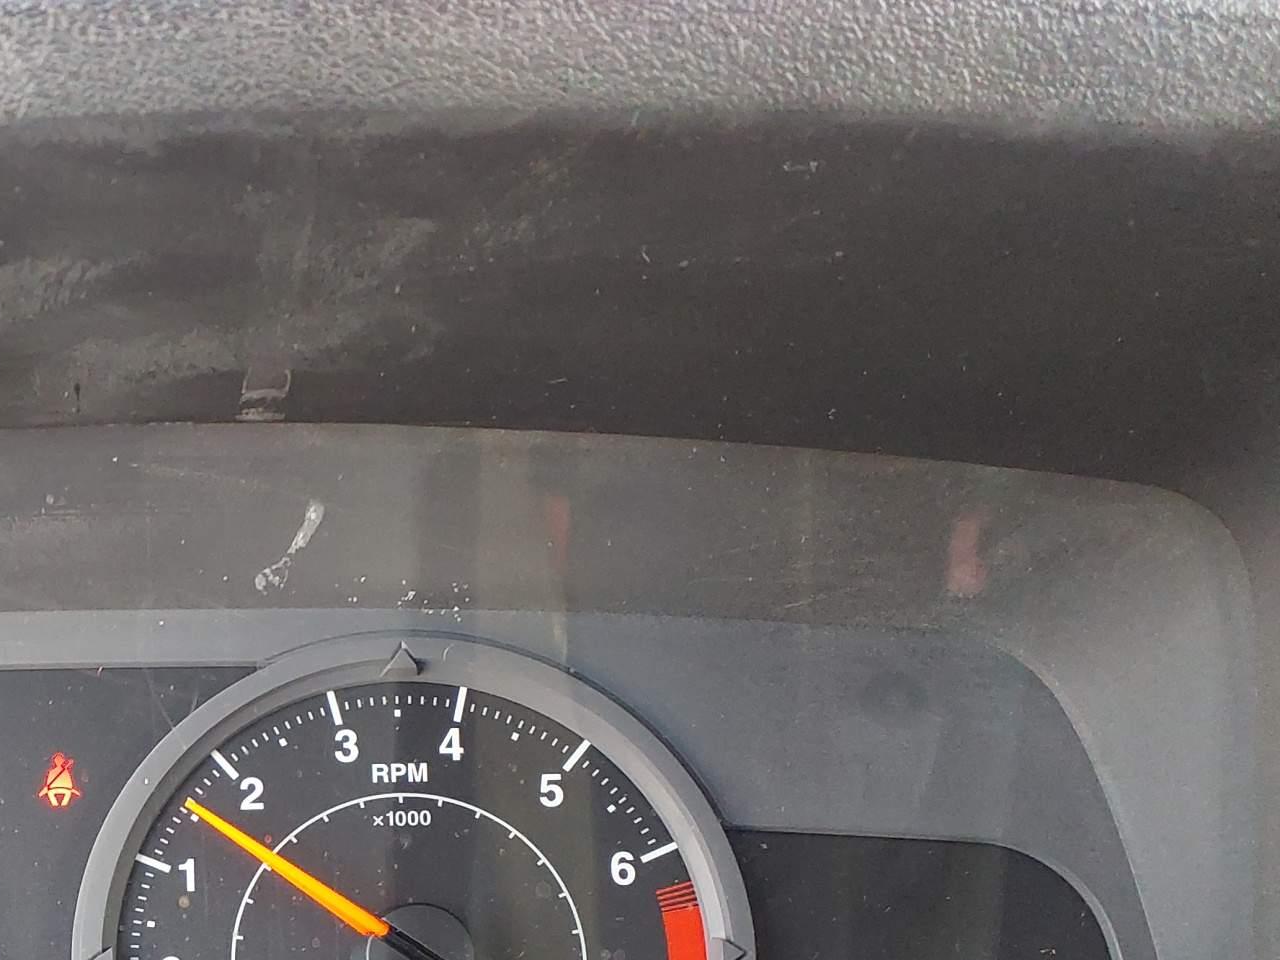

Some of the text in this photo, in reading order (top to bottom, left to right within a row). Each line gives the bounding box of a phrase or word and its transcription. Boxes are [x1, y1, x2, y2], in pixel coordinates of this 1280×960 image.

[334, 728, 359, 763] 3
[439, 727, 465, 761] 4
[371, 763, 428, 783] RPM
[539, 773, 563, 807] 5
[240, 777, 265, 810] 2
[178, 859, 196, 892] 1
[610, 851, 636, 886] 6
